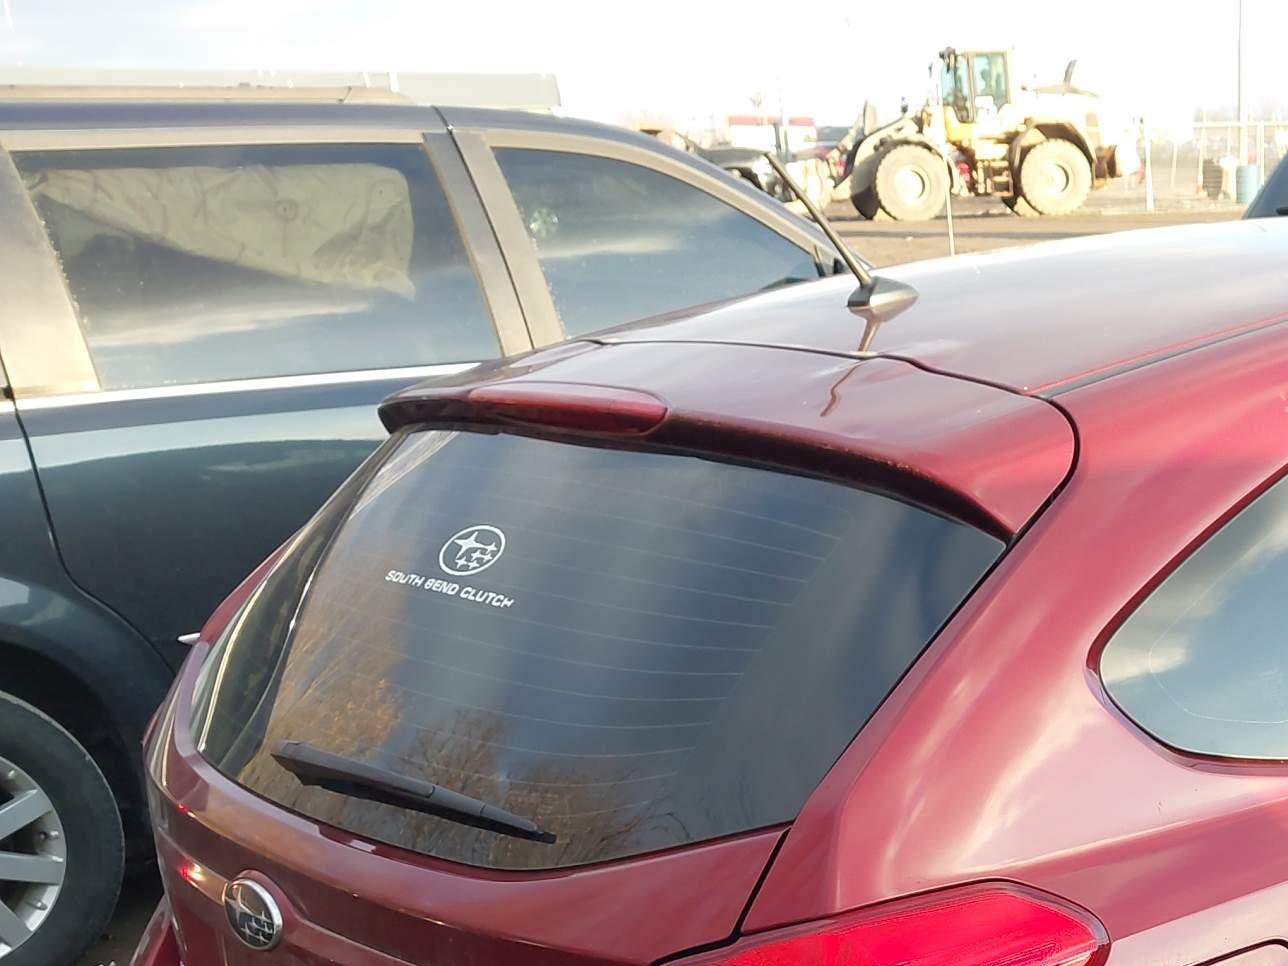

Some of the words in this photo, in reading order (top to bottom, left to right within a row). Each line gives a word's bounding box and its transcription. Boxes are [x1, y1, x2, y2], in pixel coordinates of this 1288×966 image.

[385, 569, 425, 587] SOUTH
[424, 578, 460, 596] BEND
[459, 586, 515, 608] CLUTCH
